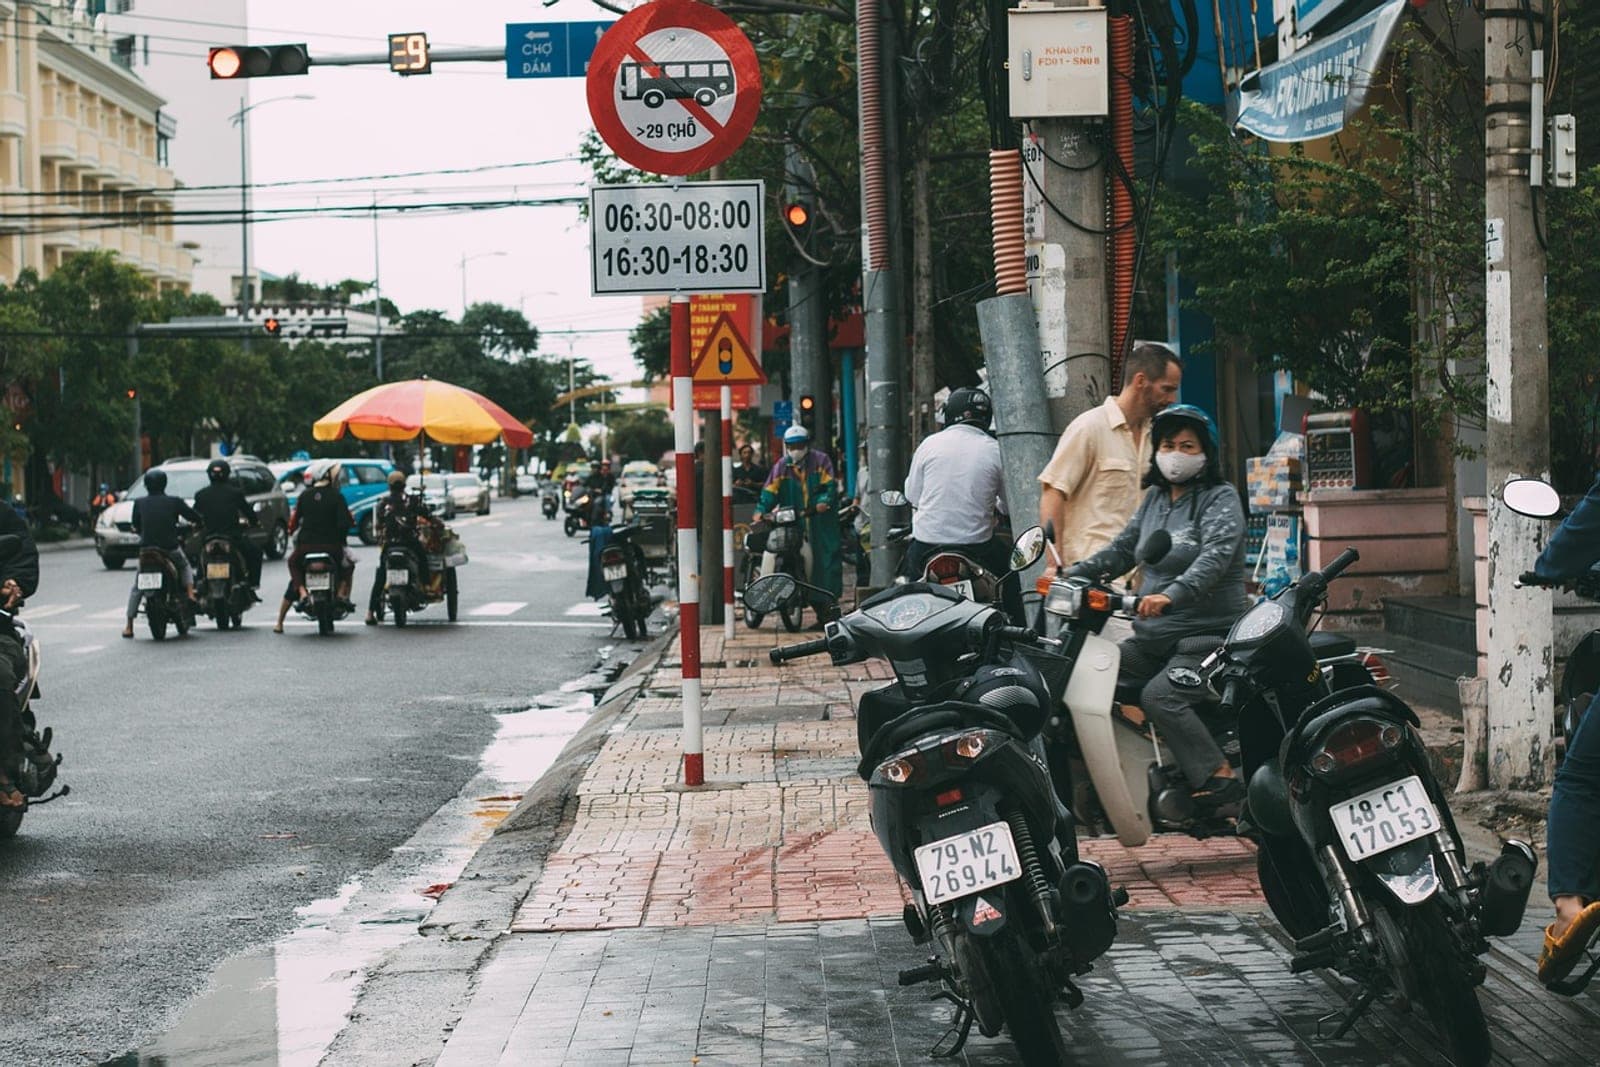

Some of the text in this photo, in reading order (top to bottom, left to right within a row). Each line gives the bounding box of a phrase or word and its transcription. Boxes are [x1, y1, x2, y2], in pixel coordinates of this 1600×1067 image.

[636, 116, 697, 139] >29 CHỖ
[605, 200, 750, 232] 06:30-08:00
[603, 243, 748, 277] 16:30-18:30
[1348, 786, 1412, 826] 48-C1
[1349, 807, 1432, 854] 170.53
[931, 832, 998, 870] 79-N2
[930, 854, 1013, 899] 269.44
